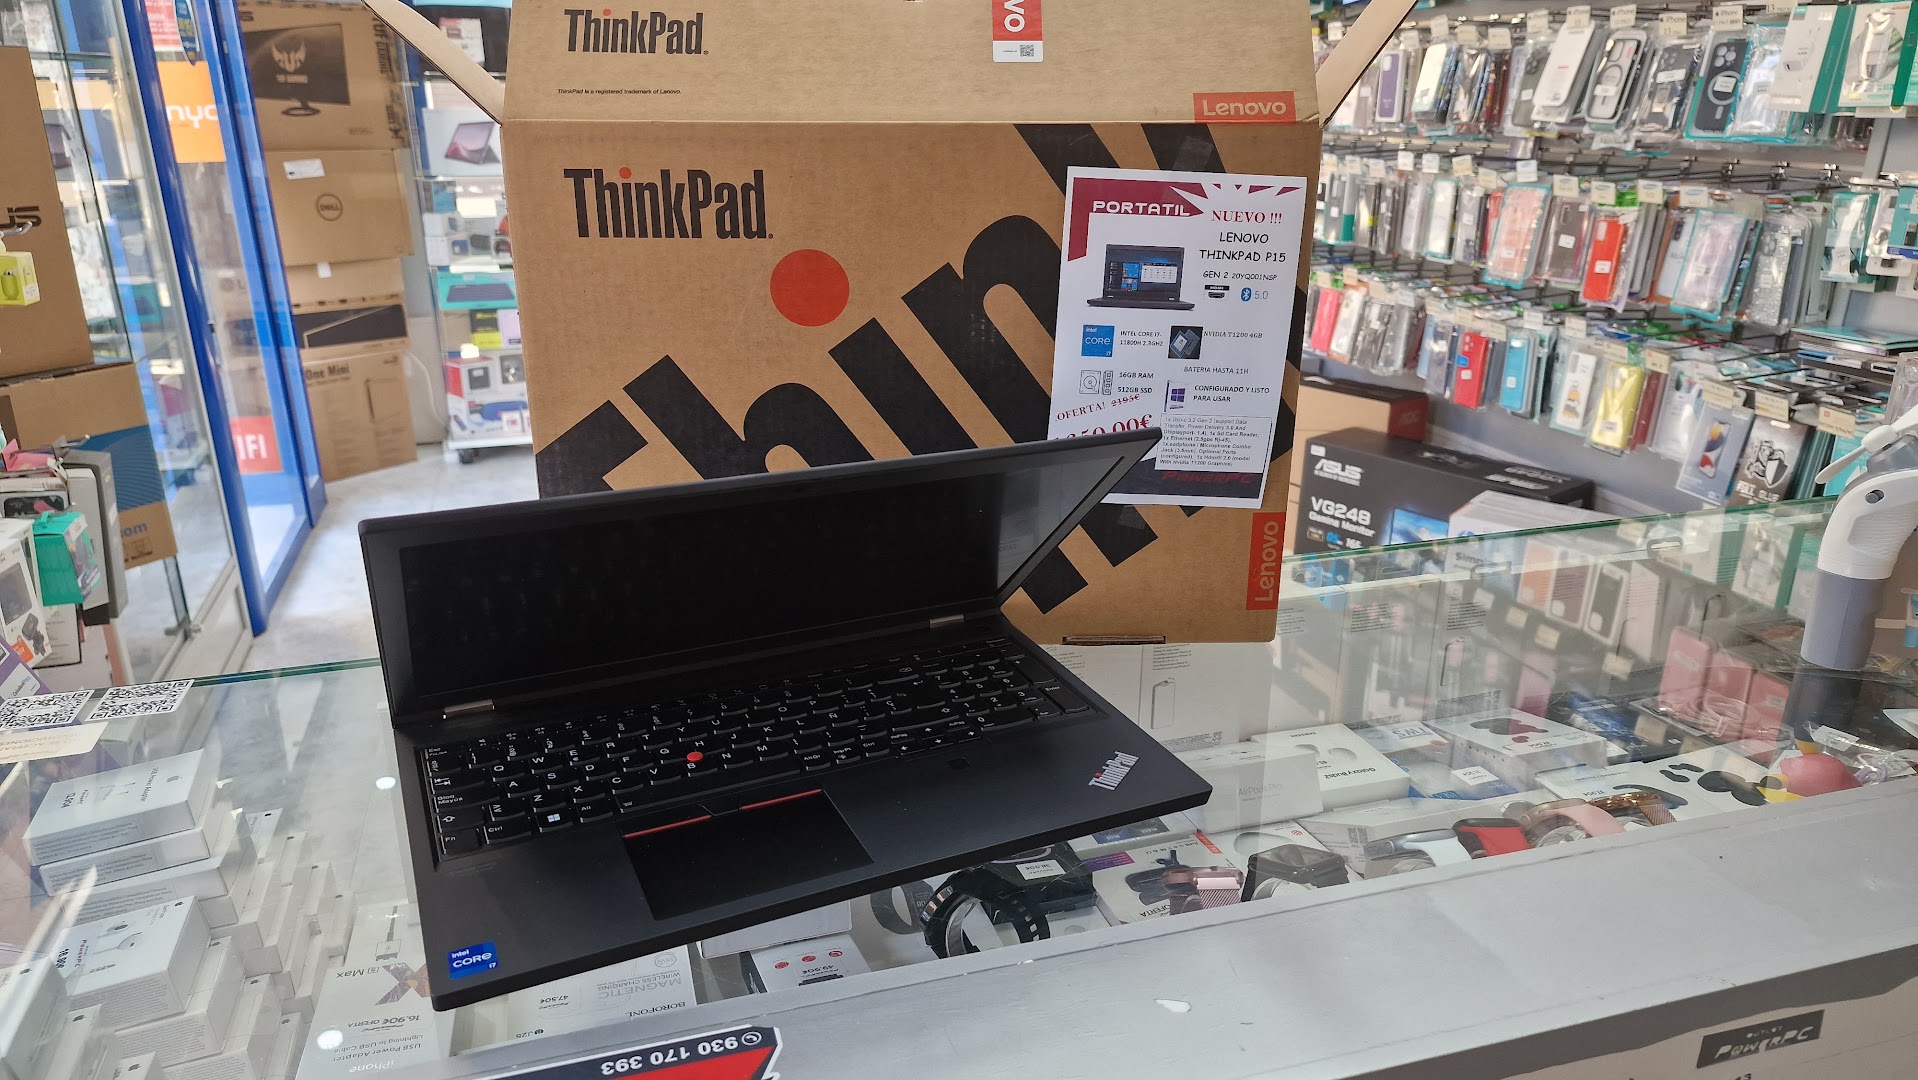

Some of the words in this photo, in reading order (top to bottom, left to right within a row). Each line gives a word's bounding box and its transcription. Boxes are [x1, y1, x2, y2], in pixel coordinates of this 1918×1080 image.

[1203, 99, 1286, 116] Lenovo
[1092, 200, 1191, 217] PORTATIL
[1211, 210, 1266, 224] NUEVO
[1270, 212, 1283, 224] !!!
[1220, 232, 1269, 244] LENOVO
[1200, 249, 1261, 262] THINKPAD
[1265, 252, 1286, 263] P15
[1202, 270, 1220, 278] GEN
[1254, 290, 1268, 300] 5.0
[1194, 384, 1244, 392] CONFIGURADO
[1314, 458, 1364, 480] ASUS
[1310, 496, 1372, 526] VG248
[1341, 520, 1376, 538] Monitor
[1255, 521, 1280, 602] Lenovo
[1088, 750, 1140, 791] ThinkPad
[1352, 766, 1376, 775] Galaxy
[452, 949, 470, 958] intel
[336, 968, 365, 979] Max
[642, 972, 681, 984] WIRELESS
[597, 979, 640, 992] CHARGING
[598, 978, 682, 1000] MAGNETIC
[347, 1018, 380, 1028] OFERTA
[382, 1014, 420, 1024] 16.90€
[388, 1034, 424, 1044] Lightning
[359, 1042, 377, 1050] USB
[372, 1046, 400, 1056] Power
[402, 1042, 421, 1052] USB
[698, 1036, 739, 1056] 930
[332, 1052, 370, 1062] Adapter
[650, 1046, 690, 1066] 170
[349, 1060, 394, 1073] iPhone
[600, 1055, 643, 1076] 393
